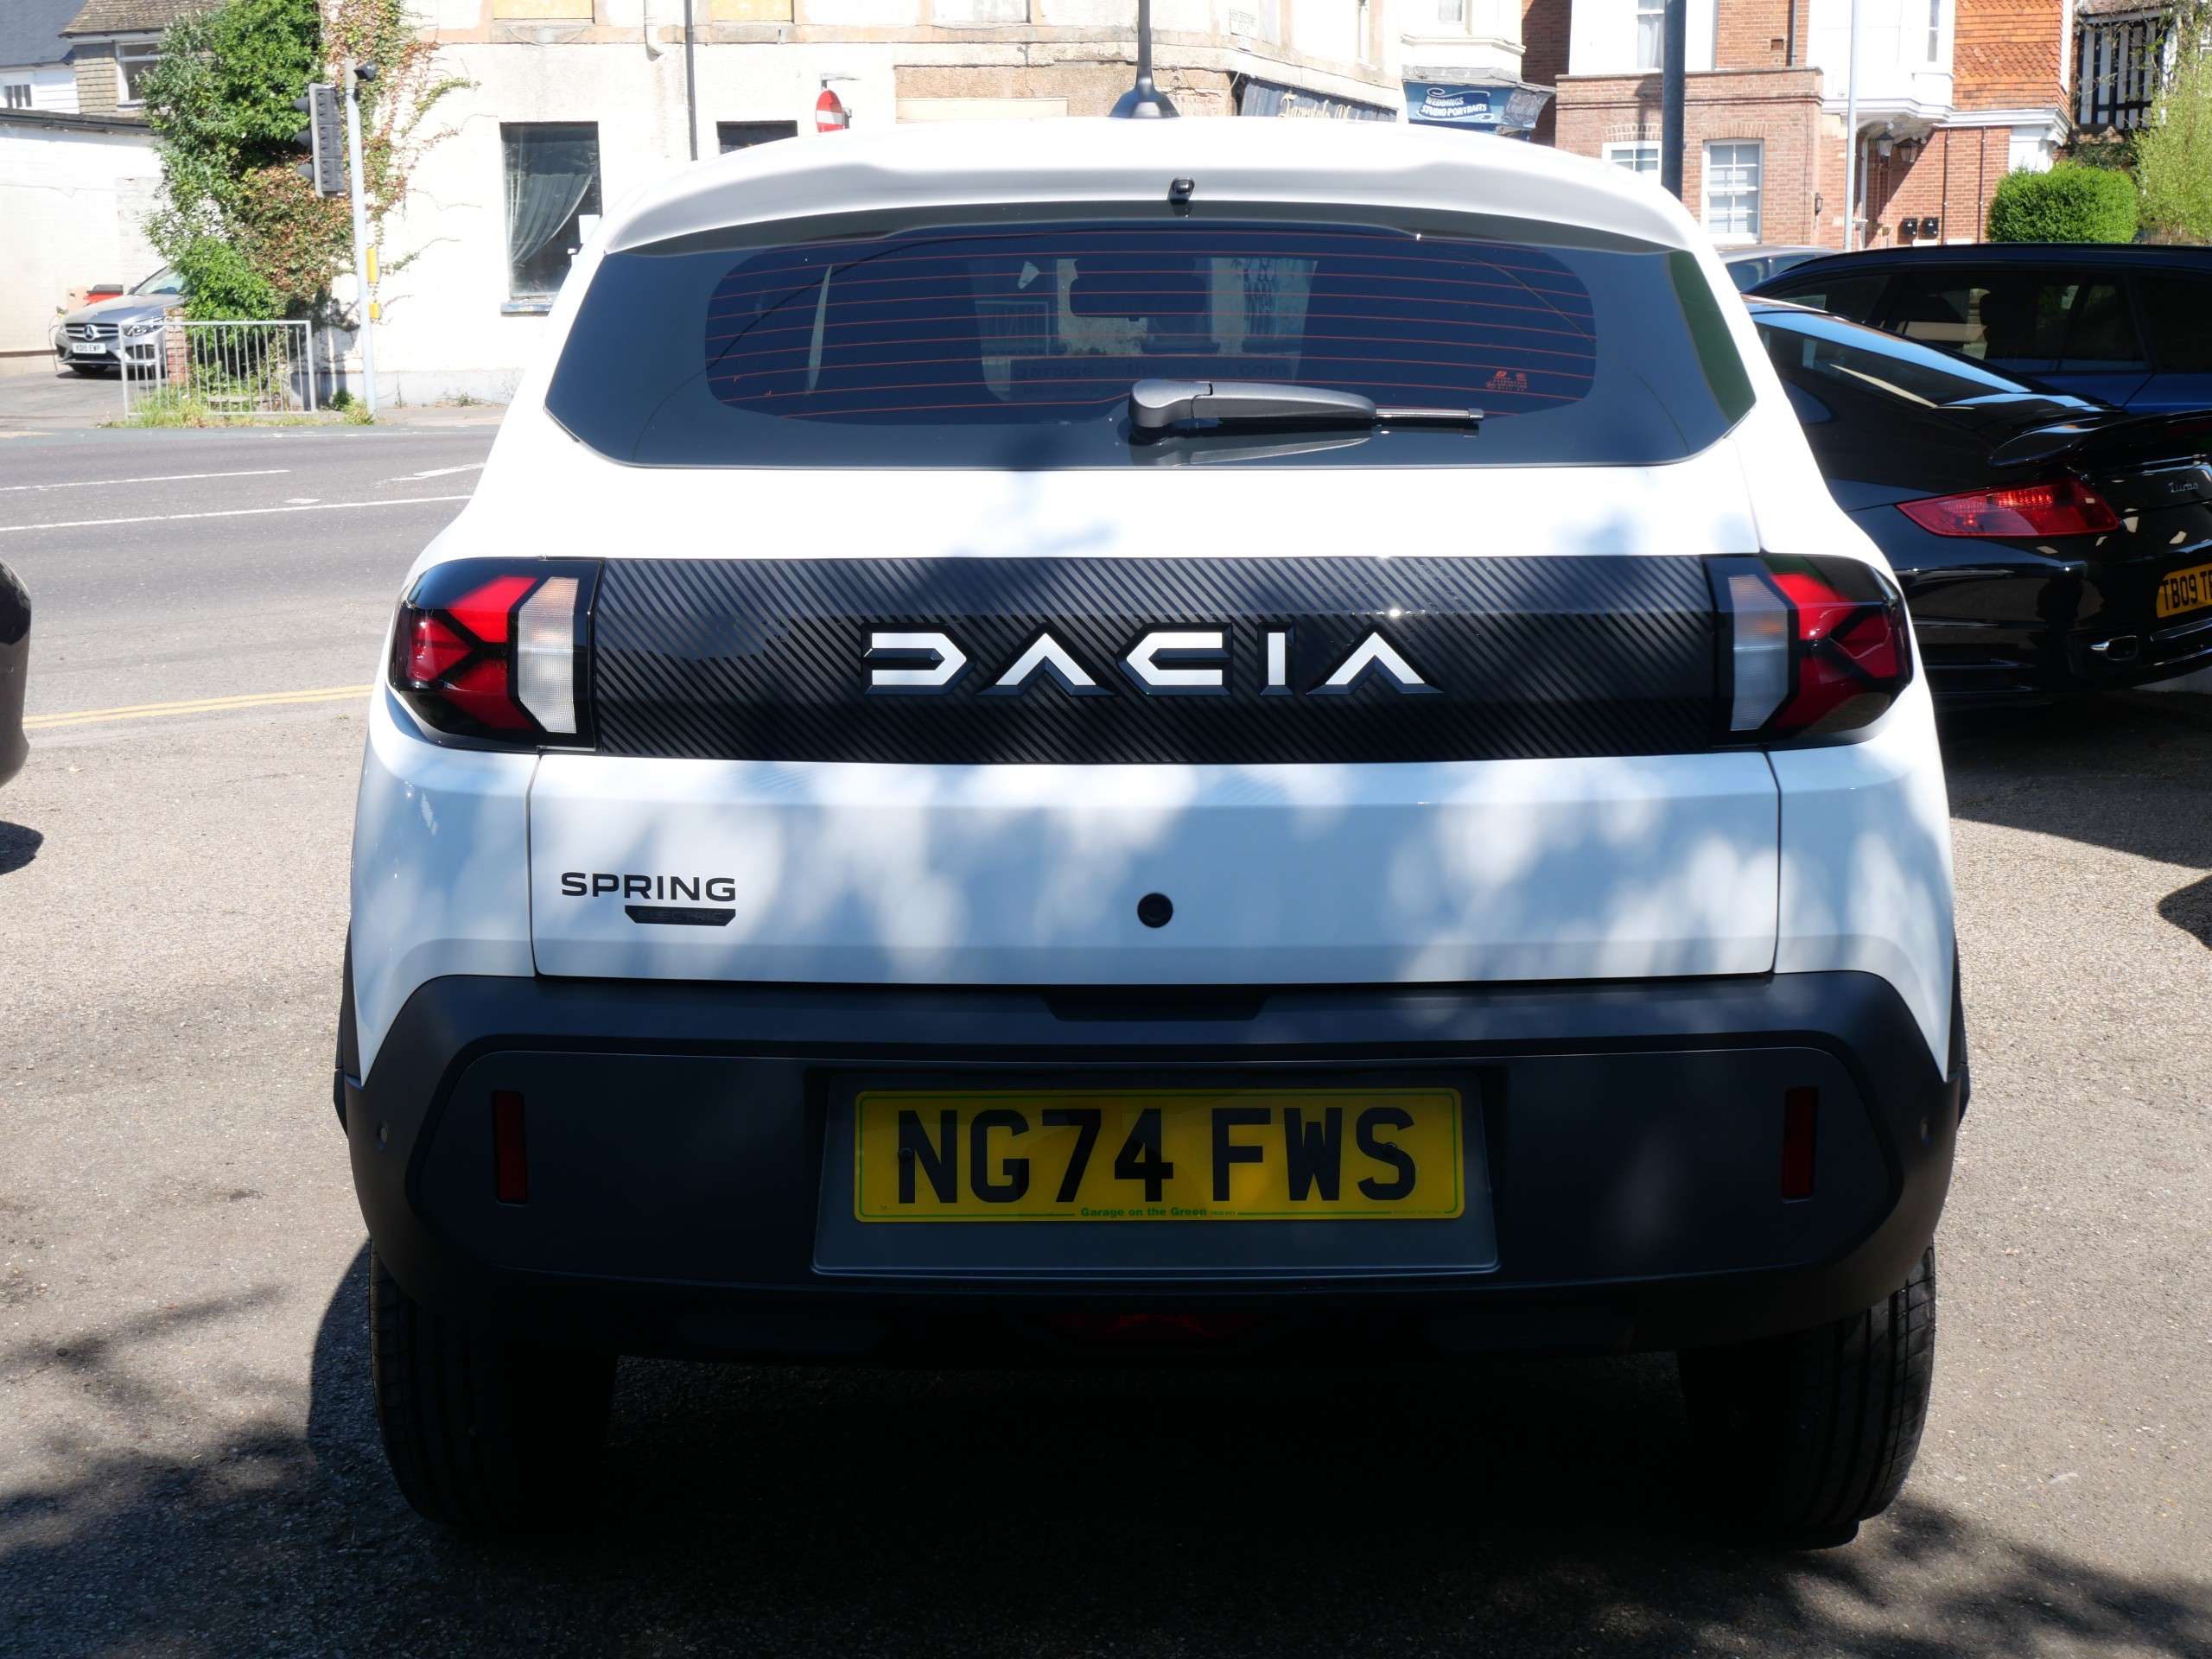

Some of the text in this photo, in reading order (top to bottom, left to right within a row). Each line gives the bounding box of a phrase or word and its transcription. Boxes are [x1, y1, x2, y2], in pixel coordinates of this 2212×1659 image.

[1421, 103, 1487, 117] STUDIO PORTRAITS
[1426, 96, 1465, 107] WEDDINGS
[2163, 574, 2197, 610] TB09
[868, 629, 1434, 691] DACIA
[561, 872, 736, 902] SPRING
[897, 1107, 1416, 1204] NG74 FWS
[1080, 1207, 1124, 1218] Garage
[1147, 1207, 1166, 1217] the
[1170, 1206, 1207, 1217] Green
